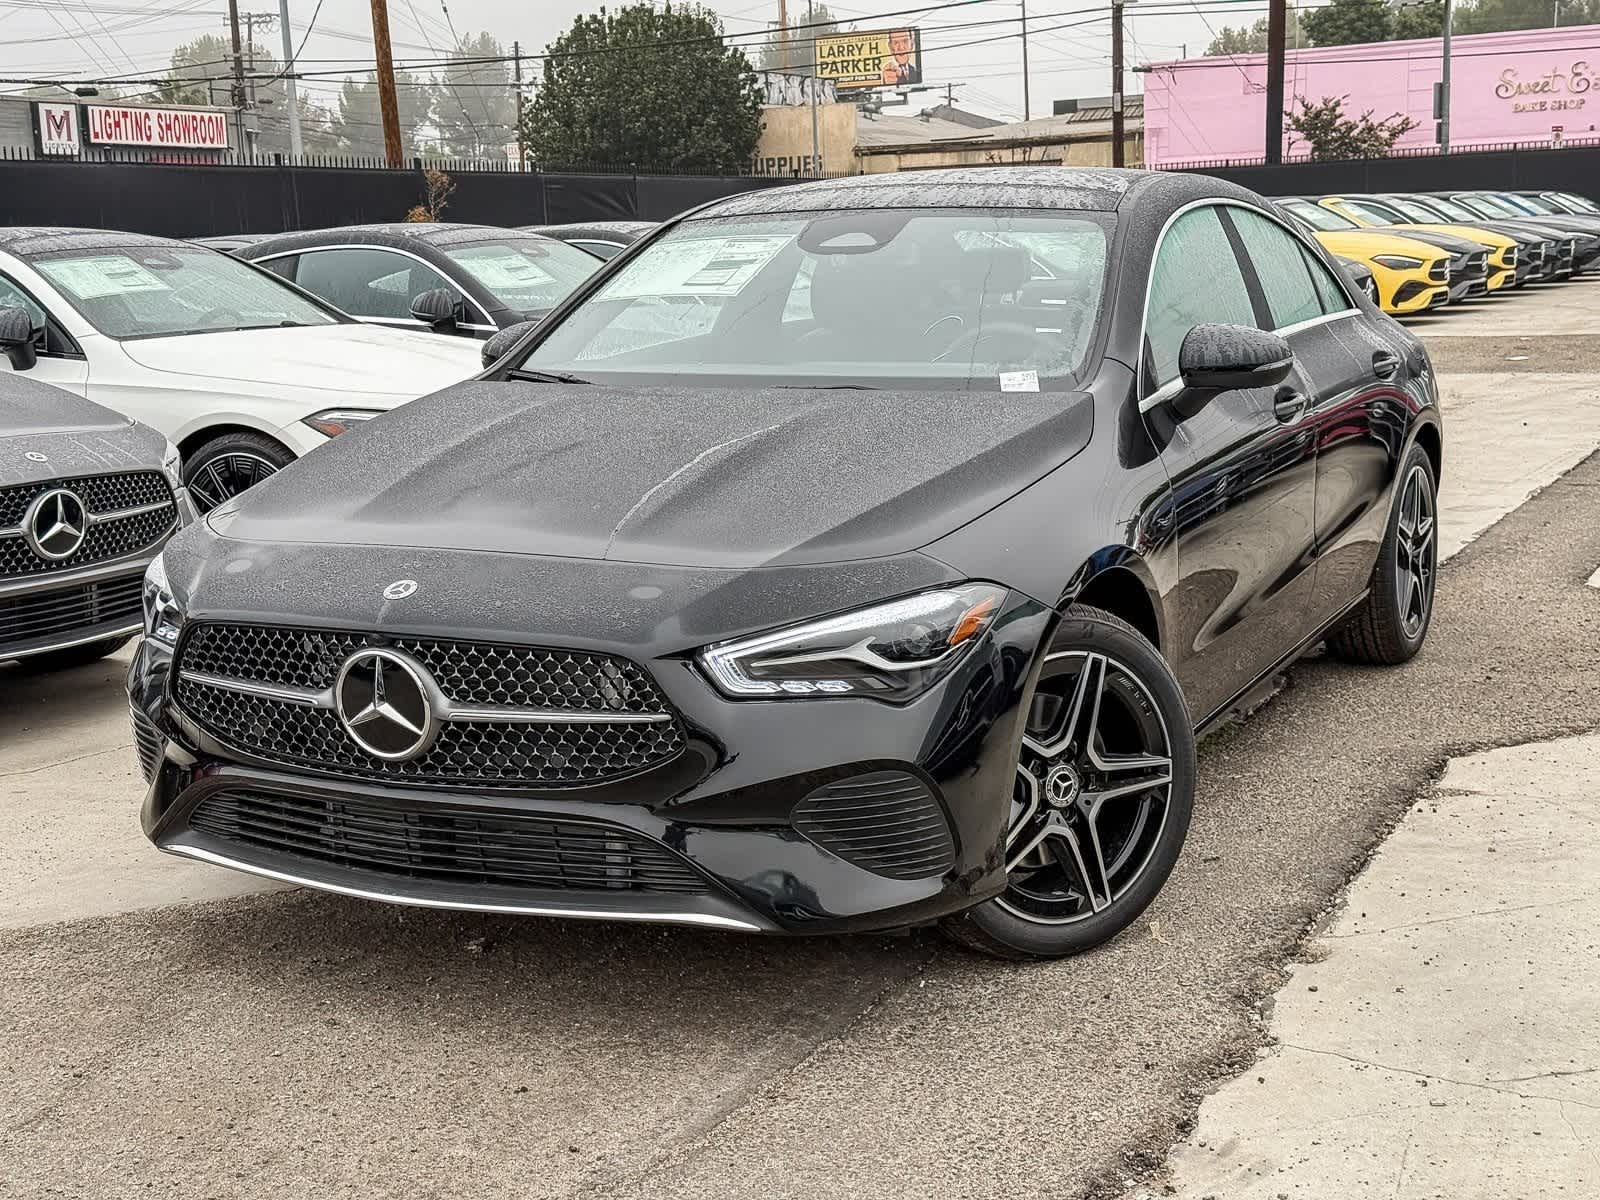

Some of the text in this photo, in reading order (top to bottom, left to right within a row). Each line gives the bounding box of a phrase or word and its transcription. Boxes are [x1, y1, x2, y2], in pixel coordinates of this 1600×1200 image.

[819, 41, 881, 58] LARRY H.
[819, 58, 882, 75] PARKER
[1495, 67, 1566, 100] Sweet
[1512, 99, 1586, 113] BAKE SHOP
[90, 108, 226, 145] LIGHTING SHOWROOM
[753, 154, 824, 175] UPPLIES
